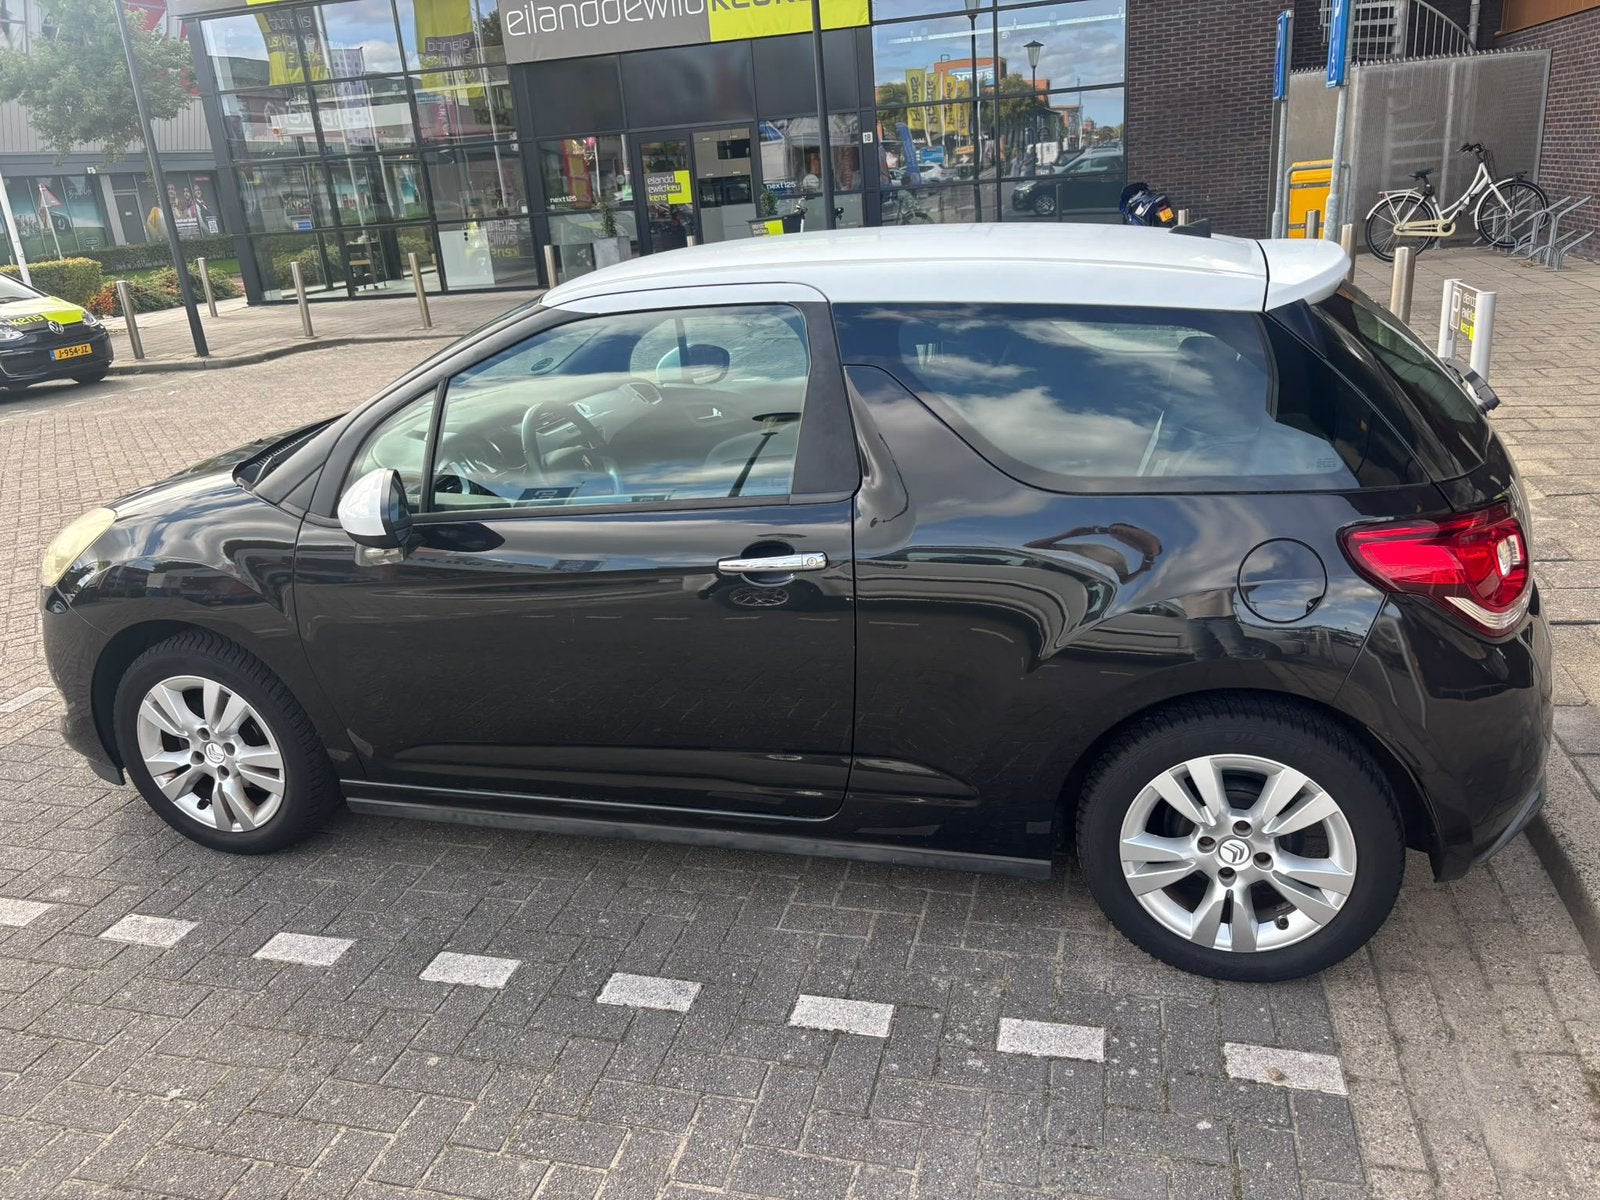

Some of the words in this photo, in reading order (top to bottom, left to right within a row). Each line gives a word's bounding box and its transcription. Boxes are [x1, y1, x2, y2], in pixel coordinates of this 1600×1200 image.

[864, 133, 871, 142] 18
[766, 181, 796, 189] next125
[649, 194, 667, 202] kens
[58, 345, 89, 359] J-954-JZ
